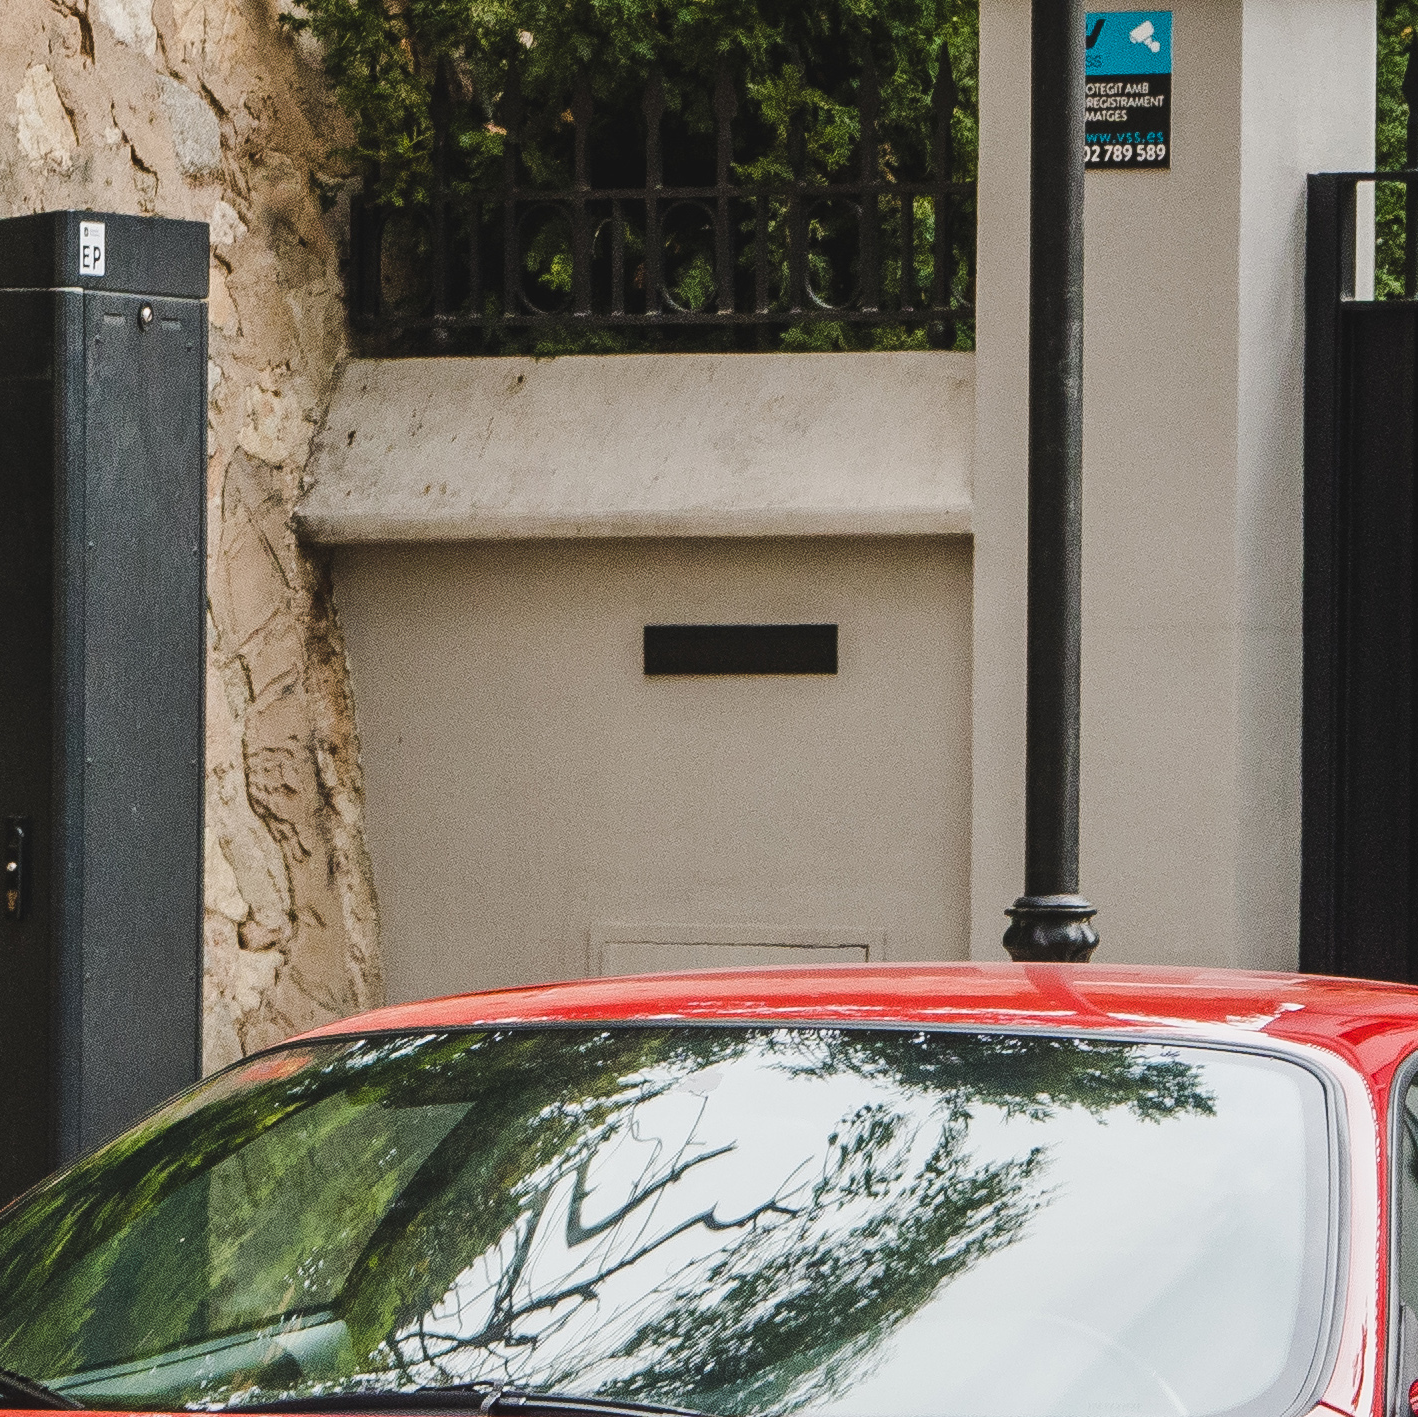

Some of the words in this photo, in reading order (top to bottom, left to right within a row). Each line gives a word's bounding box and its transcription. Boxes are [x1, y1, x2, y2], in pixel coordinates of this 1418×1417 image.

[1085, 82, 1123, 95] OTEGIT
[1125, 82, 1149, 94] AMB
[1086, 95, 1164, 108] REGISTRAMENT
[1085, 109, 1128, 122] MATGES
[1085, 131, 1164, 143] ww.vss.es
[1084, 145, 1101, 162] 02
[1103, 144, 1133, 162] 789
[1136, 143, 1166, 161] 589
[83, 245, 101, 269] EP
